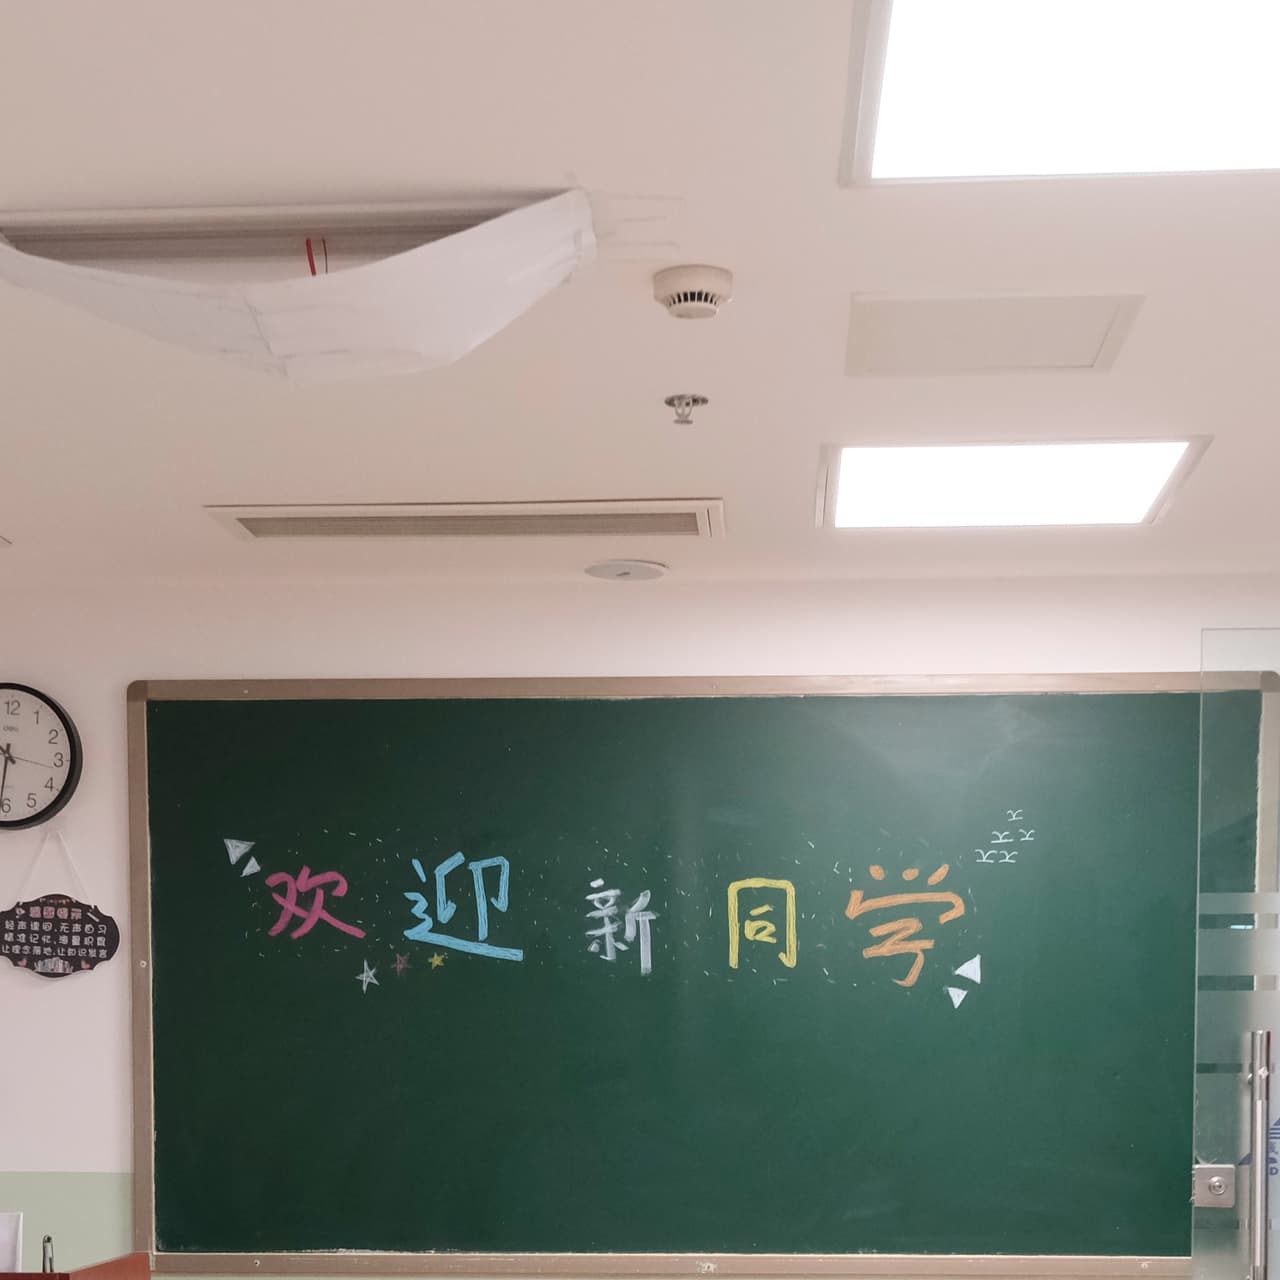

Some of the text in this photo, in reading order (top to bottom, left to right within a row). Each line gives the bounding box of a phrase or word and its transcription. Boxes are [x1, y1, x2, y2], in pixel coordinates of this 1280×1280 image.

[4, 700, 21, 716] 12
[33, 709, 40, 725] 1
[47, 728, 59, 745] 2
[53, 752, 64, 768] 3
[44, 776, 54, 792] 4
[0, 797, 12, 814] 6
[26, 792, 38, 809] 5
